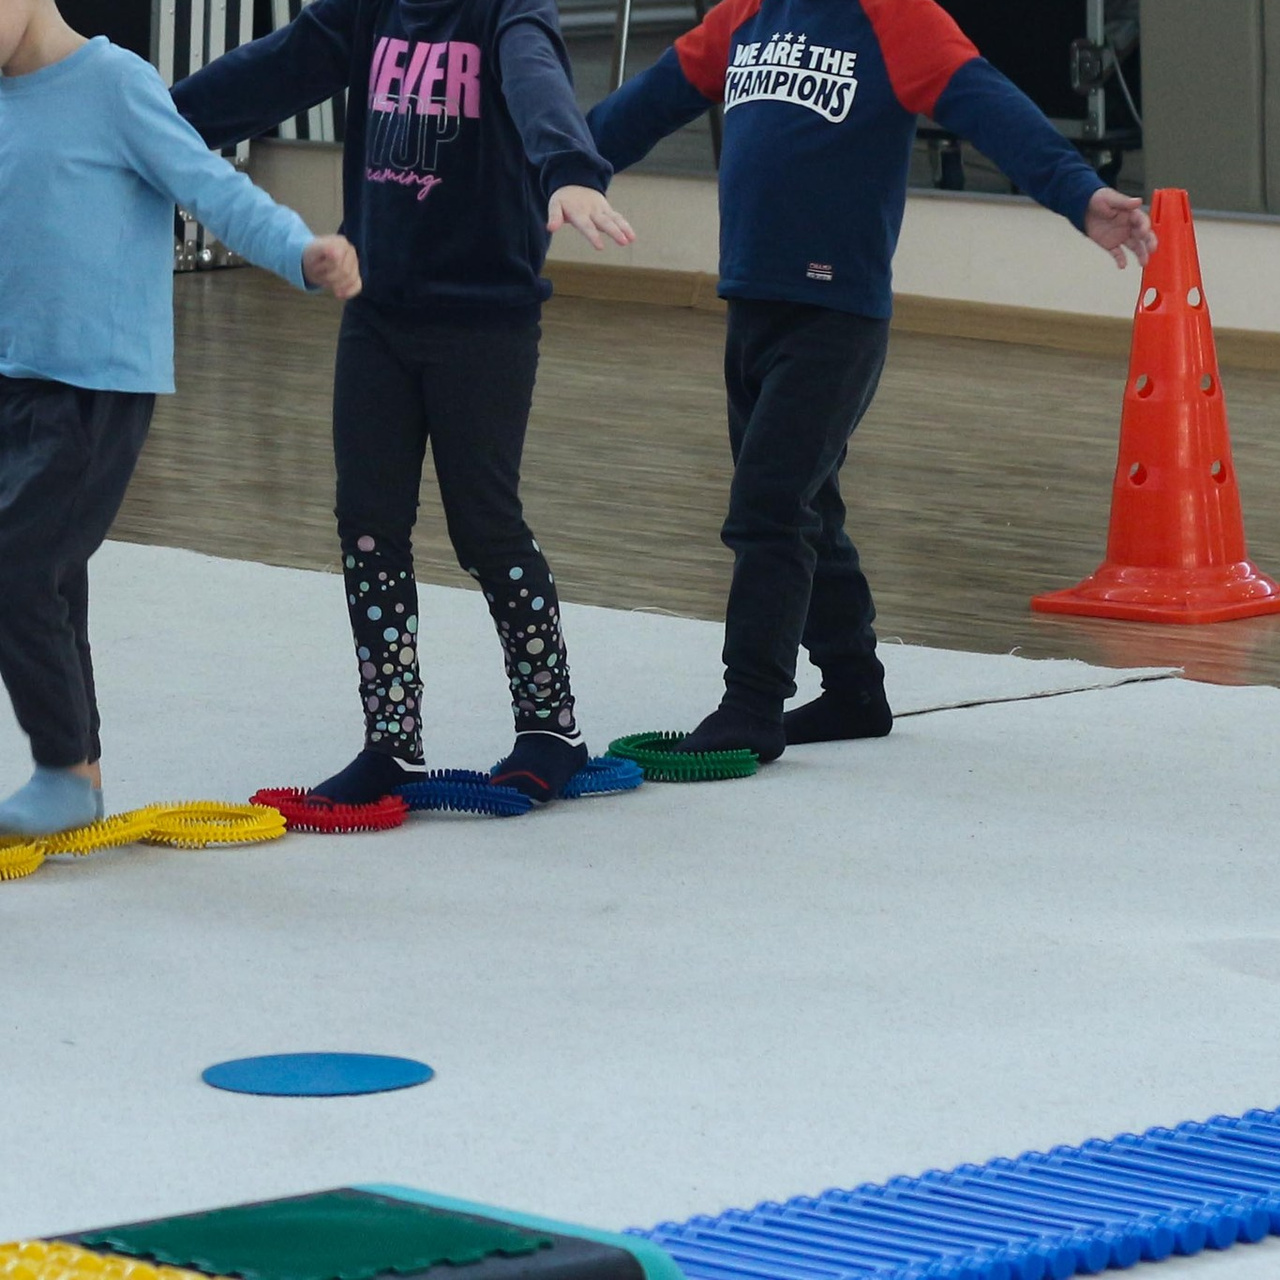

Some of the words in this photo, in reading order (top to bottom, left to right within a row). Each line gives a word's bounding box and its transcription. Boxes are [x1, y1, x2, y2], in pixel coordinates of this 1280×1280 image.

[759, 41, 805, 67] ARE
[809, 45, 857, 76] THE
[726, 71, 852, 118] HAMPIONS
